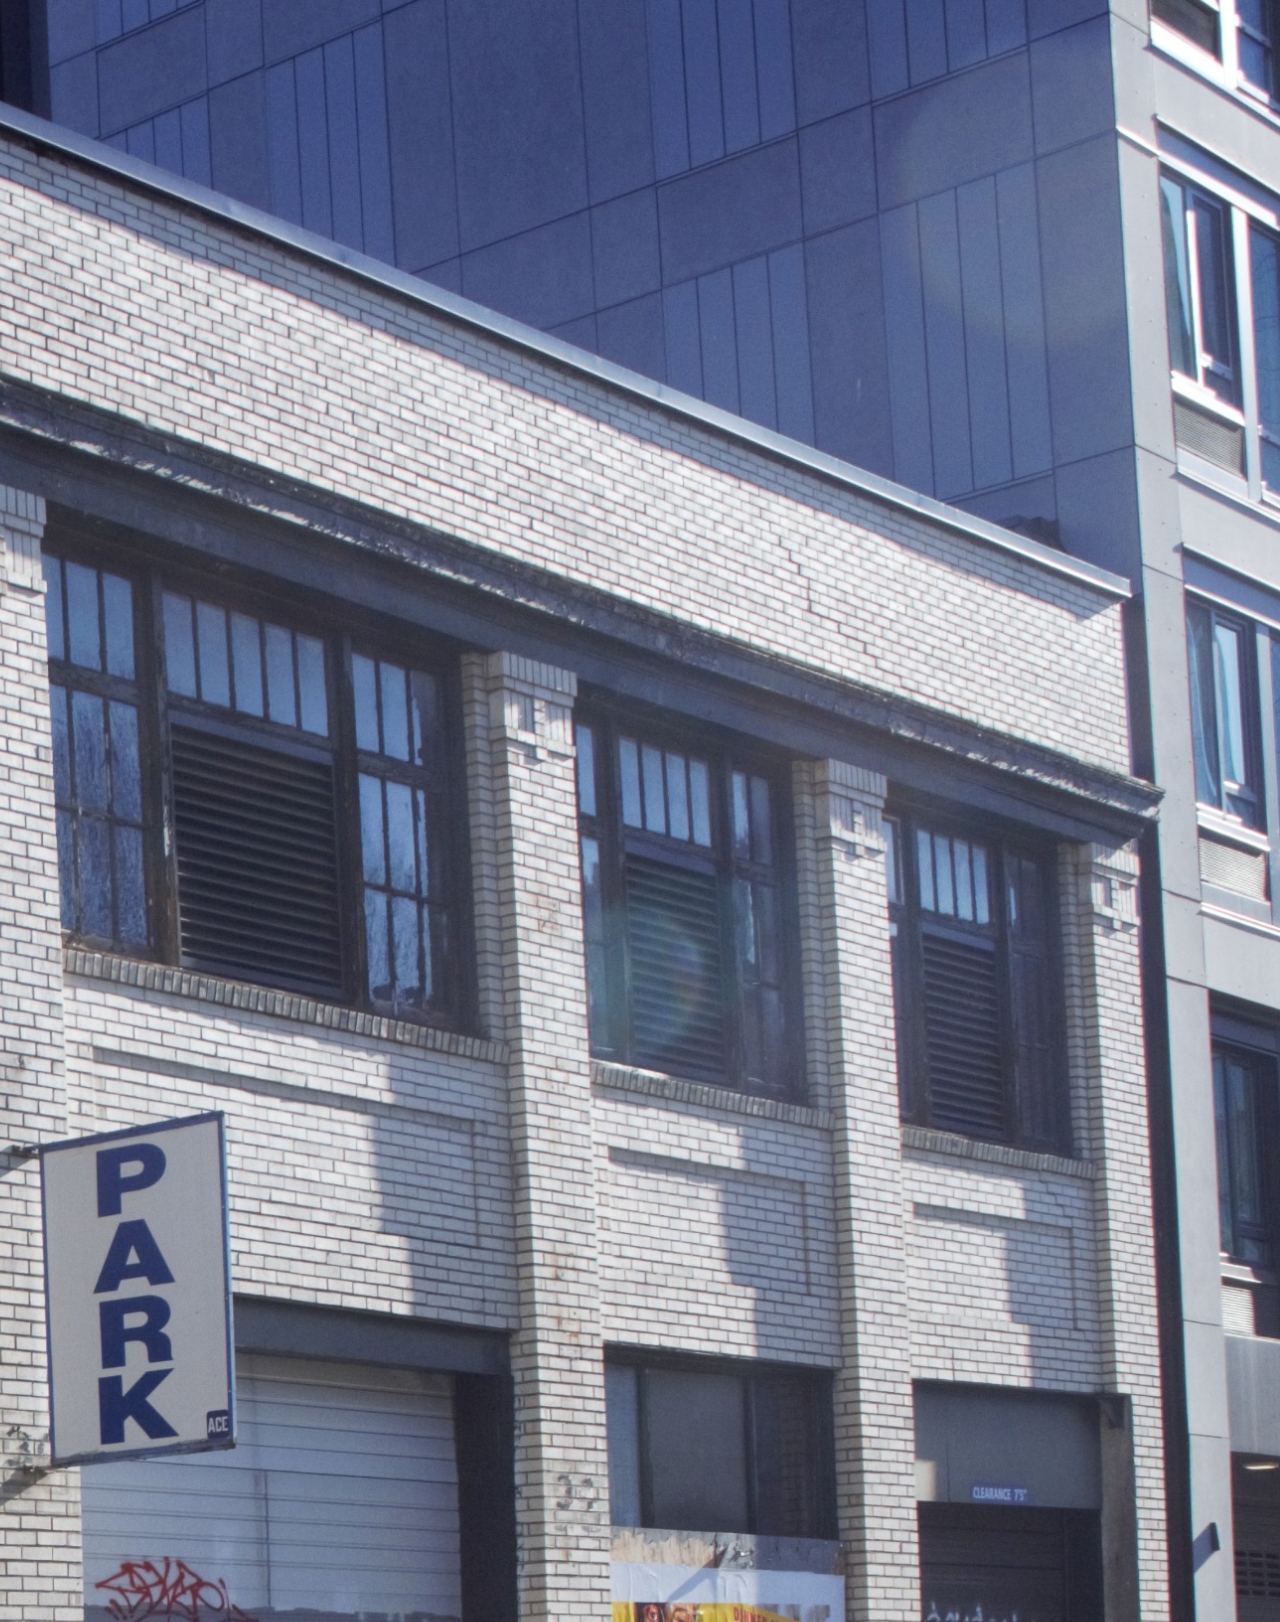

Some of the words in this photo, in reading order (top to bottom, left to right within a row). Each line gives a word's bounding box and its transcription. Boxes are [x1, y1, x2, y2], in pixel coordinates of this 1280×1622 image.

[93, 1142, 180, 1445] PARK
[207, 1415, 230, 1435] ACE
[973, 1487, 1011, 1500] CLEARANCE
